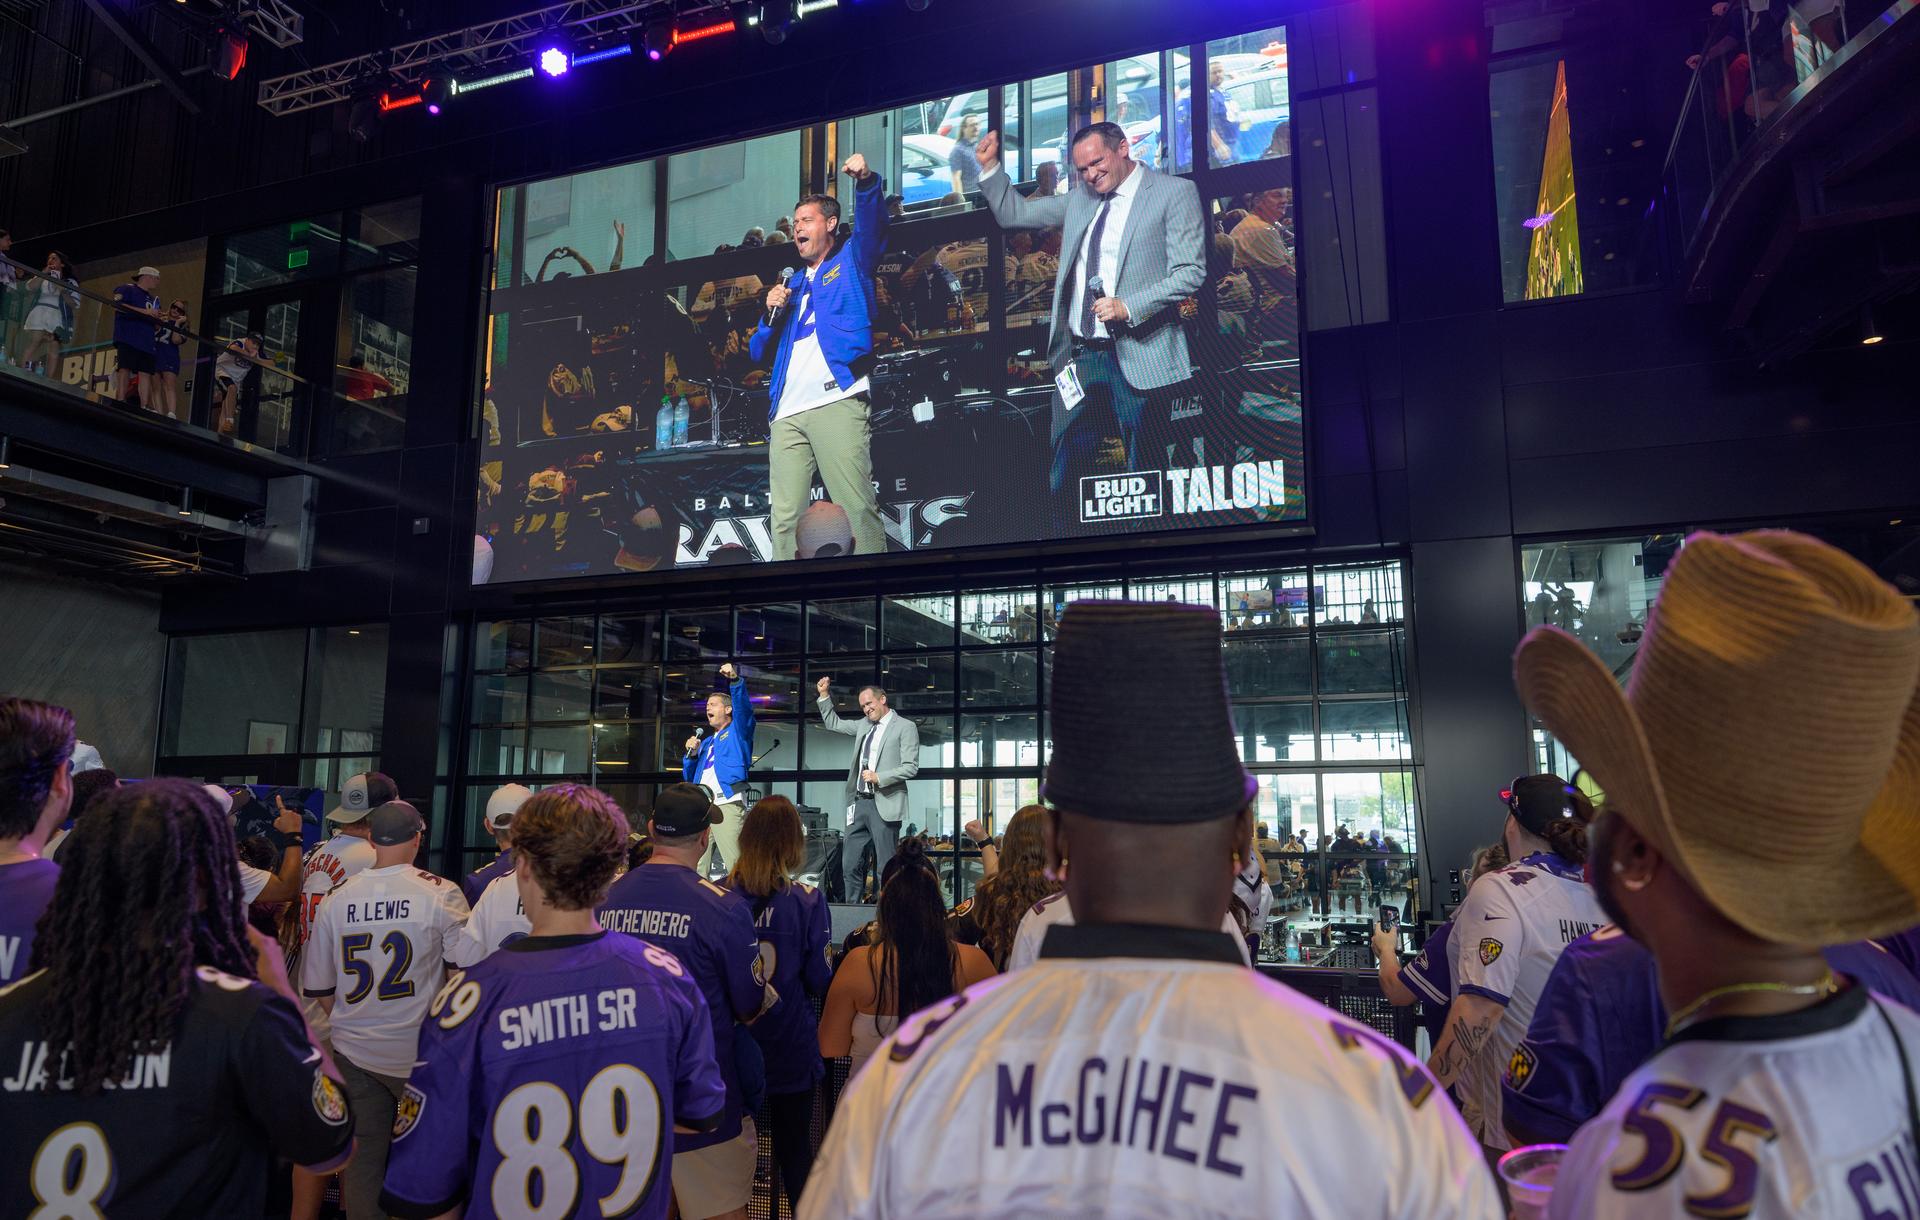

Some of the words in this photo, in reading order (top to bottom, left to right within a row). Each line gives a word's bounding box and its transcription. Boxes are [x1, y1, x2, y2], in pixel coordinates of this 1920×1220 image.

[1085, 494, 1157, 517] LIGHT
[1095, 477, 1146, 498] BUD
[1166, 460, 1285, 514] TALON
[364, 900, 410, 922] LEWIS
[341, 930, 415, 1005] 52
[430, 971, 482, 1030] 89
[499, 993, 590, 1051] SMITH
[597, 987, 638, 1032] SR
[490, 1063, 666, 1220] 89
[1610, 1080, 1779, 1219] 55
